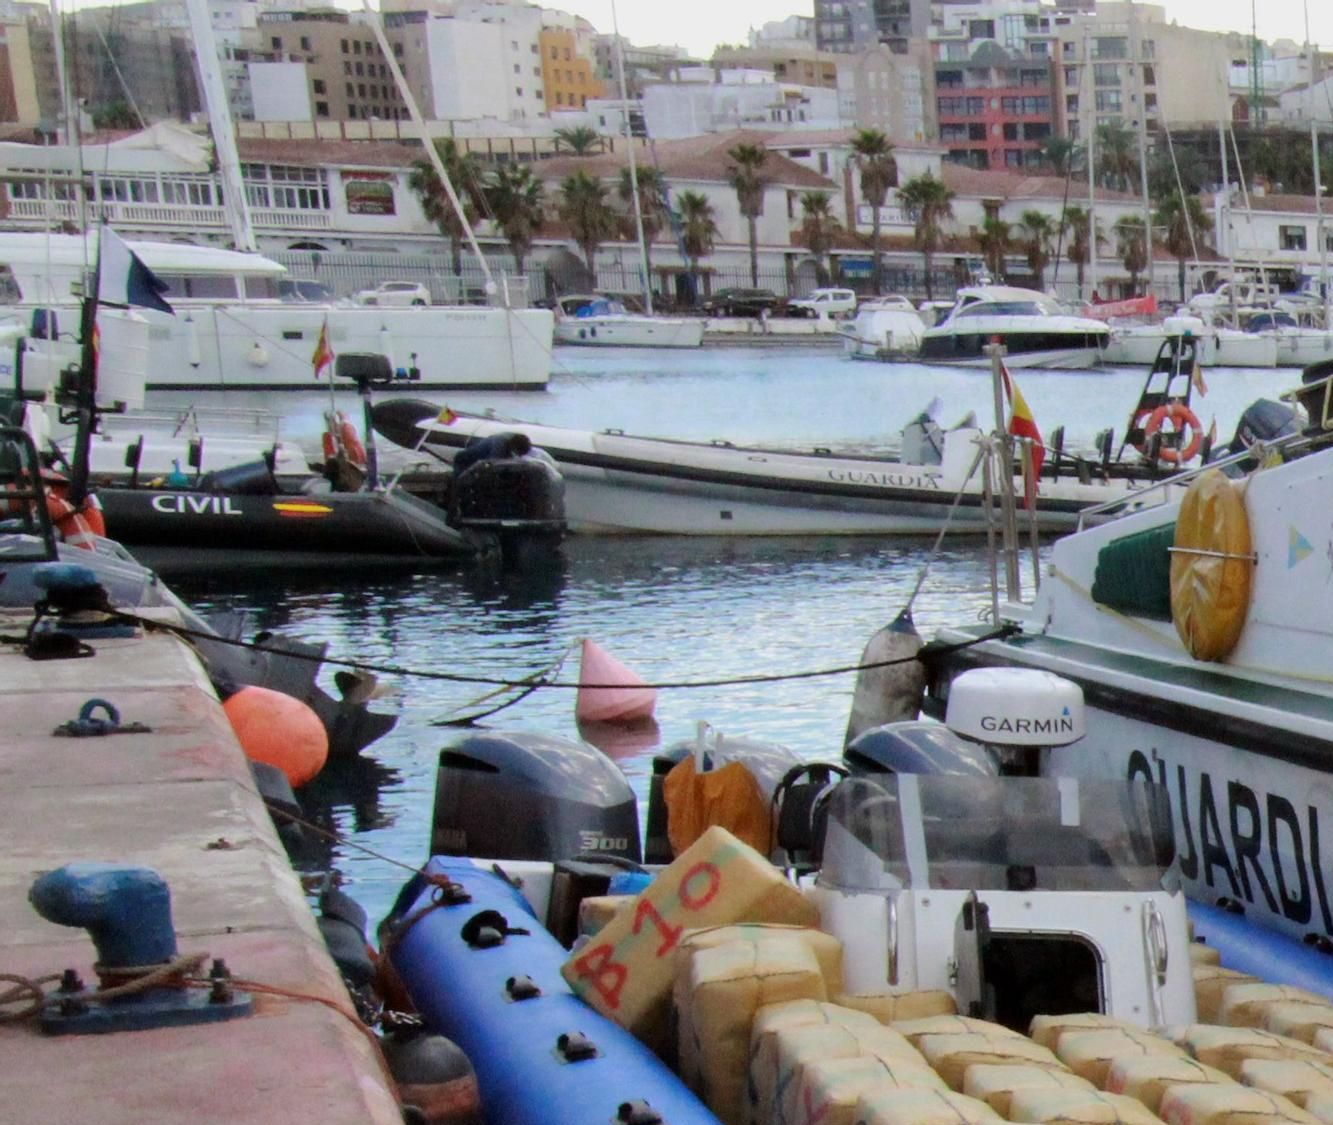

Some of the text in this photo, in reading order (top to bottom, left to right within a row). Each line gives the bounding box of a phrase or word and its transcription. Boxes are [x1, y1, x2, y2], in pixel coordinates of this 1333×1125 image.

[828, 470, 940, 489] GUARDIA
[152, 495, 243, 515] CIVIL
[981, 716, 1073, 733] GARMIN
[580, 836, 628, 850] 300
